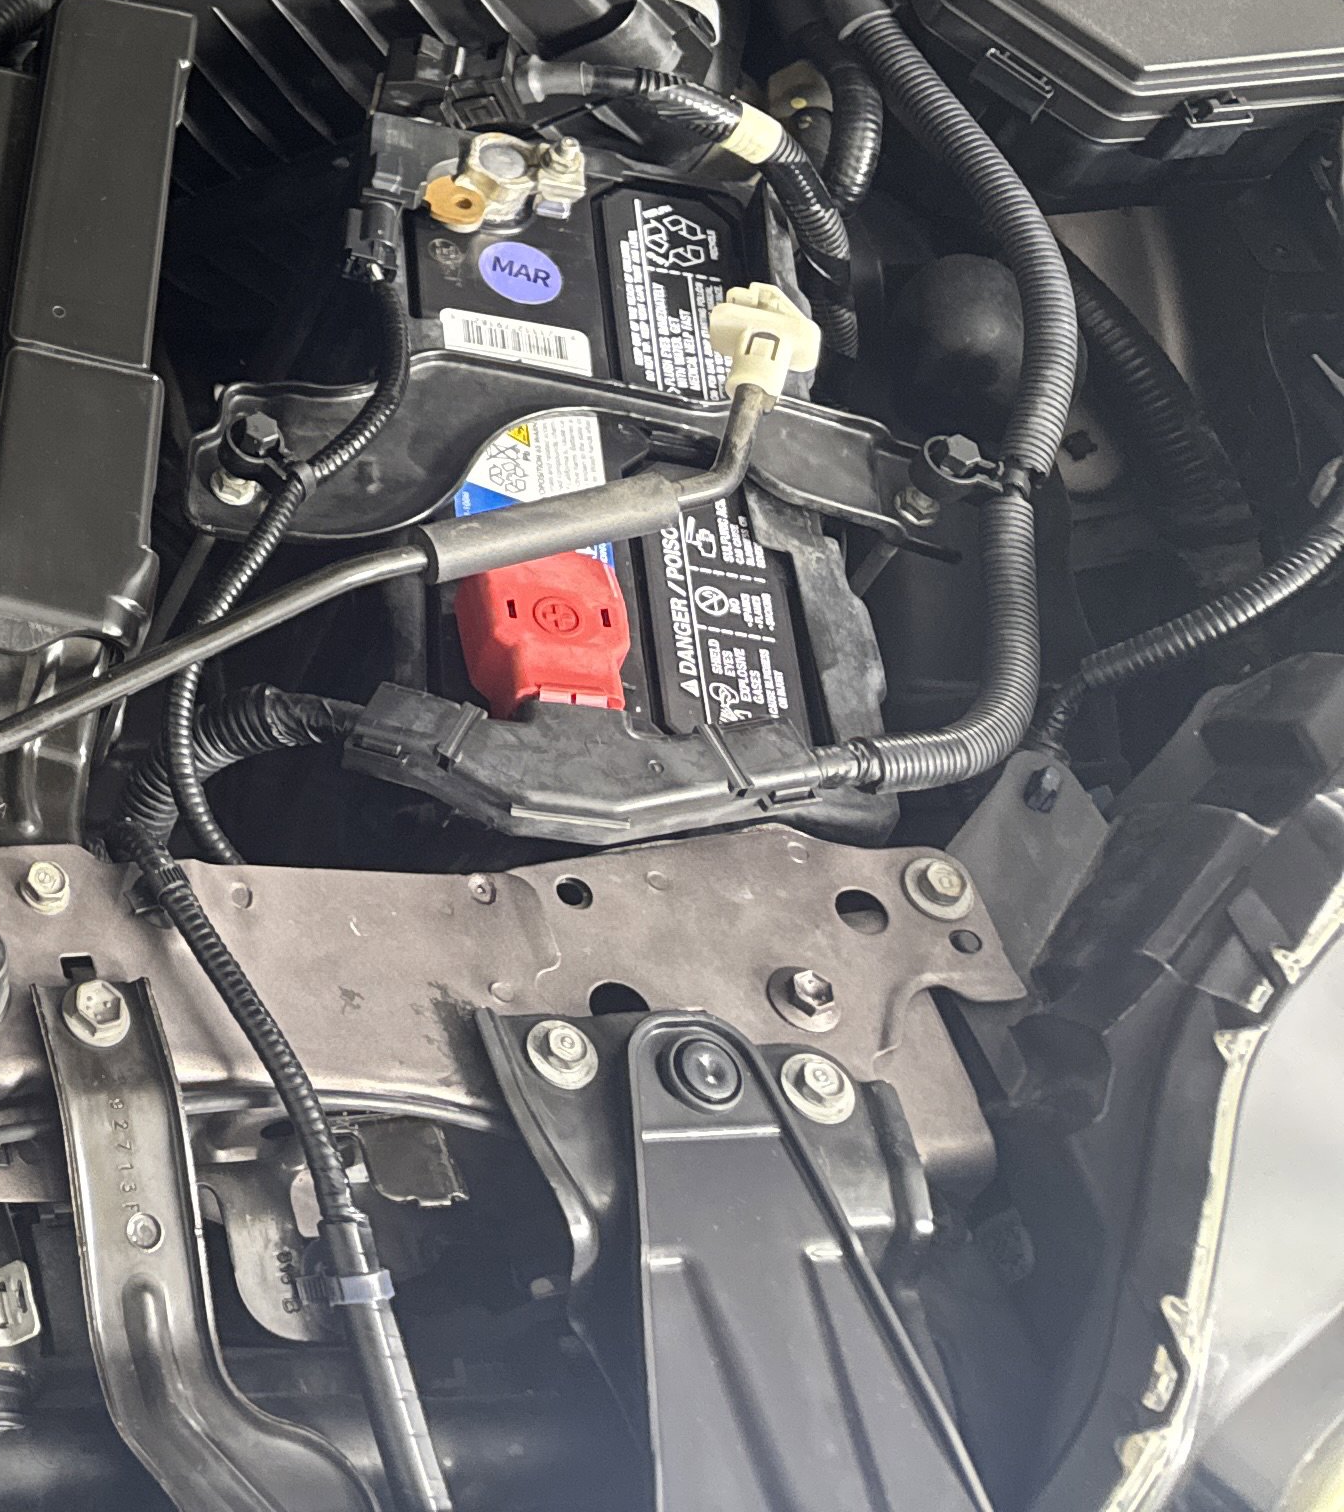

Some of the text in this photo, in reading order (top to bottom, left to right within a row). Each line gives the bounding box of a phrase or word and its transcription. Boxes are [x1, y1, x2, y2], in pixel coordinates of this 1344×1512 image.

[492, 256, 551, 287] MAR
[660, 527, 685, 580] POISO
[729, 598, 741, 614] NO
[670, 597, 697, 676] DANGER
[708, 638, 724, 675] SHIELD
[722, 650, 736, 677] EYES
[733, 647, 752, 702] EXPLOSIVE
[749, 670, 765, 704] GASES
